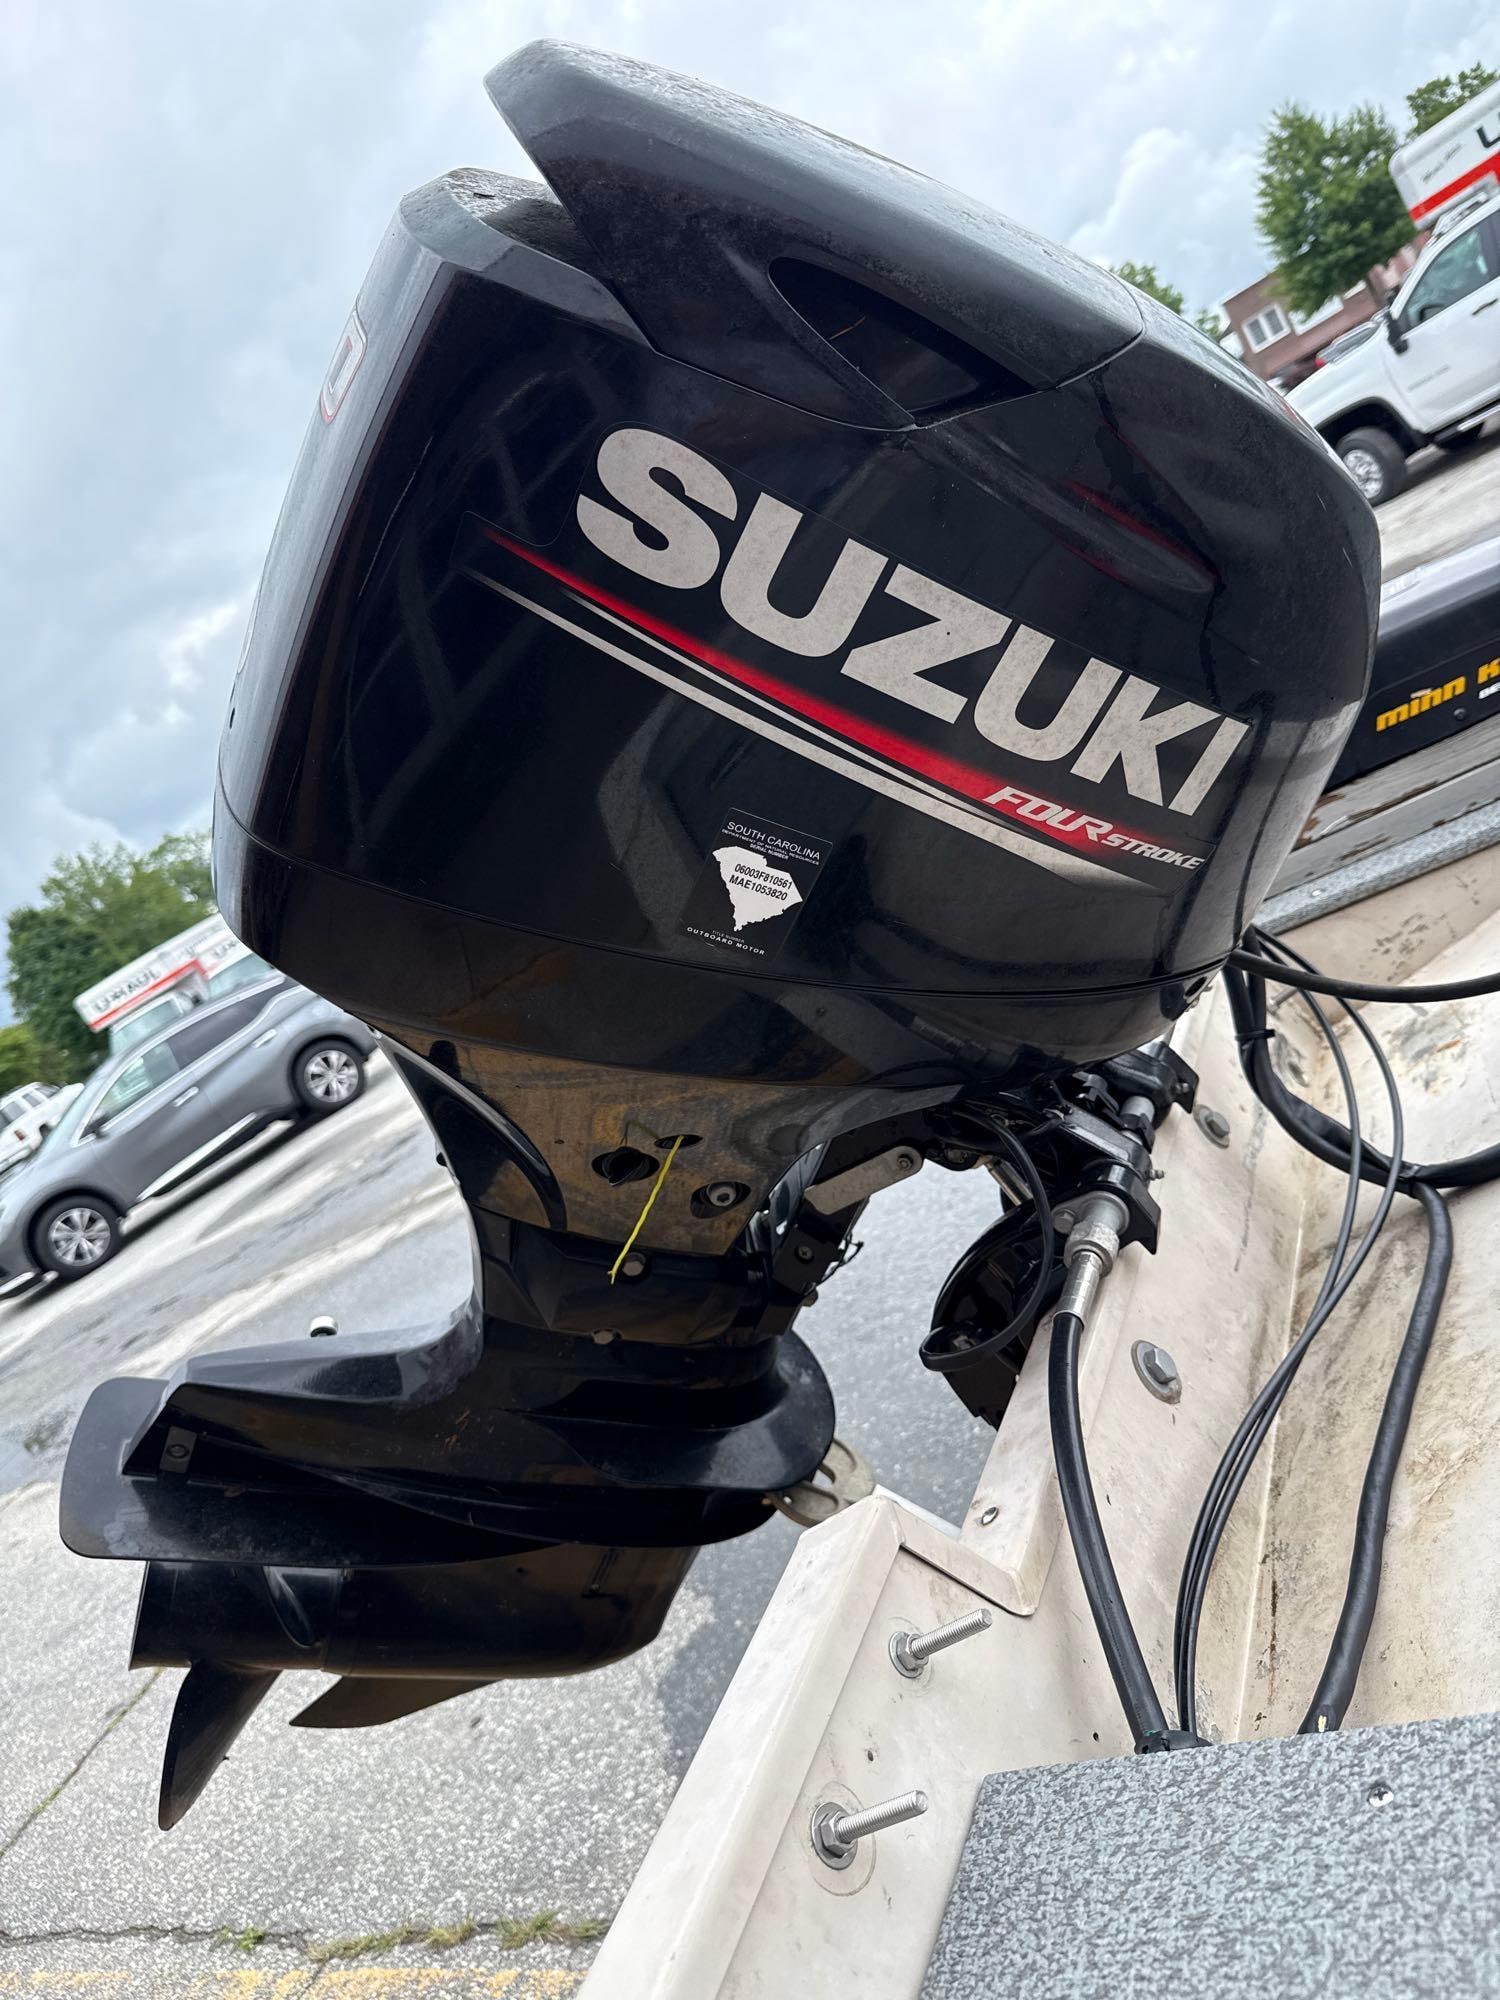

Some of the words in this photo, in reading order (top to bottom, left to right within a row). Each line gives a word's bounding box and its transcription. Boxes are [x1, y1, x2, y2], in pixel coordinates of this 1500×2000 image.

[577, 428, 1250, 816] SUZUKI
[1375, 675, 1467, 732] minn
[727, 821, 766, 841] SOUTH
[767, 836, 820, 860] CAROLINA
[982, 786, 1114, 842] FOUR
[1101, 833, 1205, 870] STROKE
[729, 874, 788, 901] MAE1053820
[734, 863, 792, 890] 06003F810561
[687, 926, 733, 945] OUTBOARD
[736, 942, 765, 955] MOTOR
